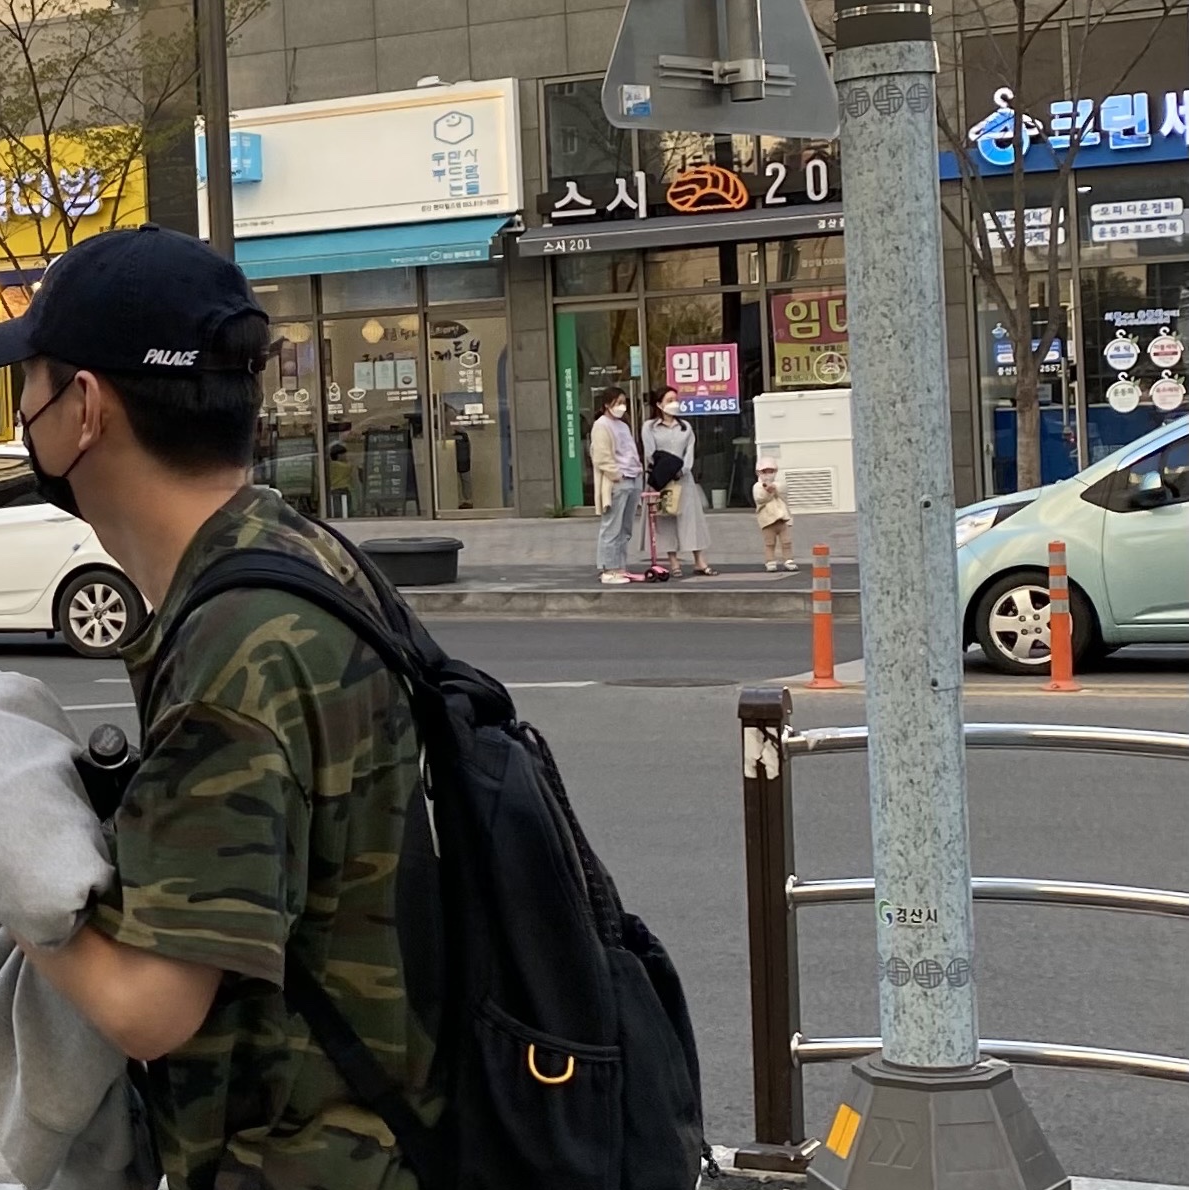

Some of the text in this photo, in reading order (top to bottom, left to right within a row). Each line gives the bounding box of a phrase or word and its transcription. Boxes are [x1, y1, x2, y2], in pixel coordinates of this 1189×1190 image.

[551, 171, 648, 219] 스시
[543, 239, 592, 251] 스시 201
[143, 348, 200, 366] PALACE
[672, 351, 731, 383] 임대
[896, 908, 938, 923] 경산시
